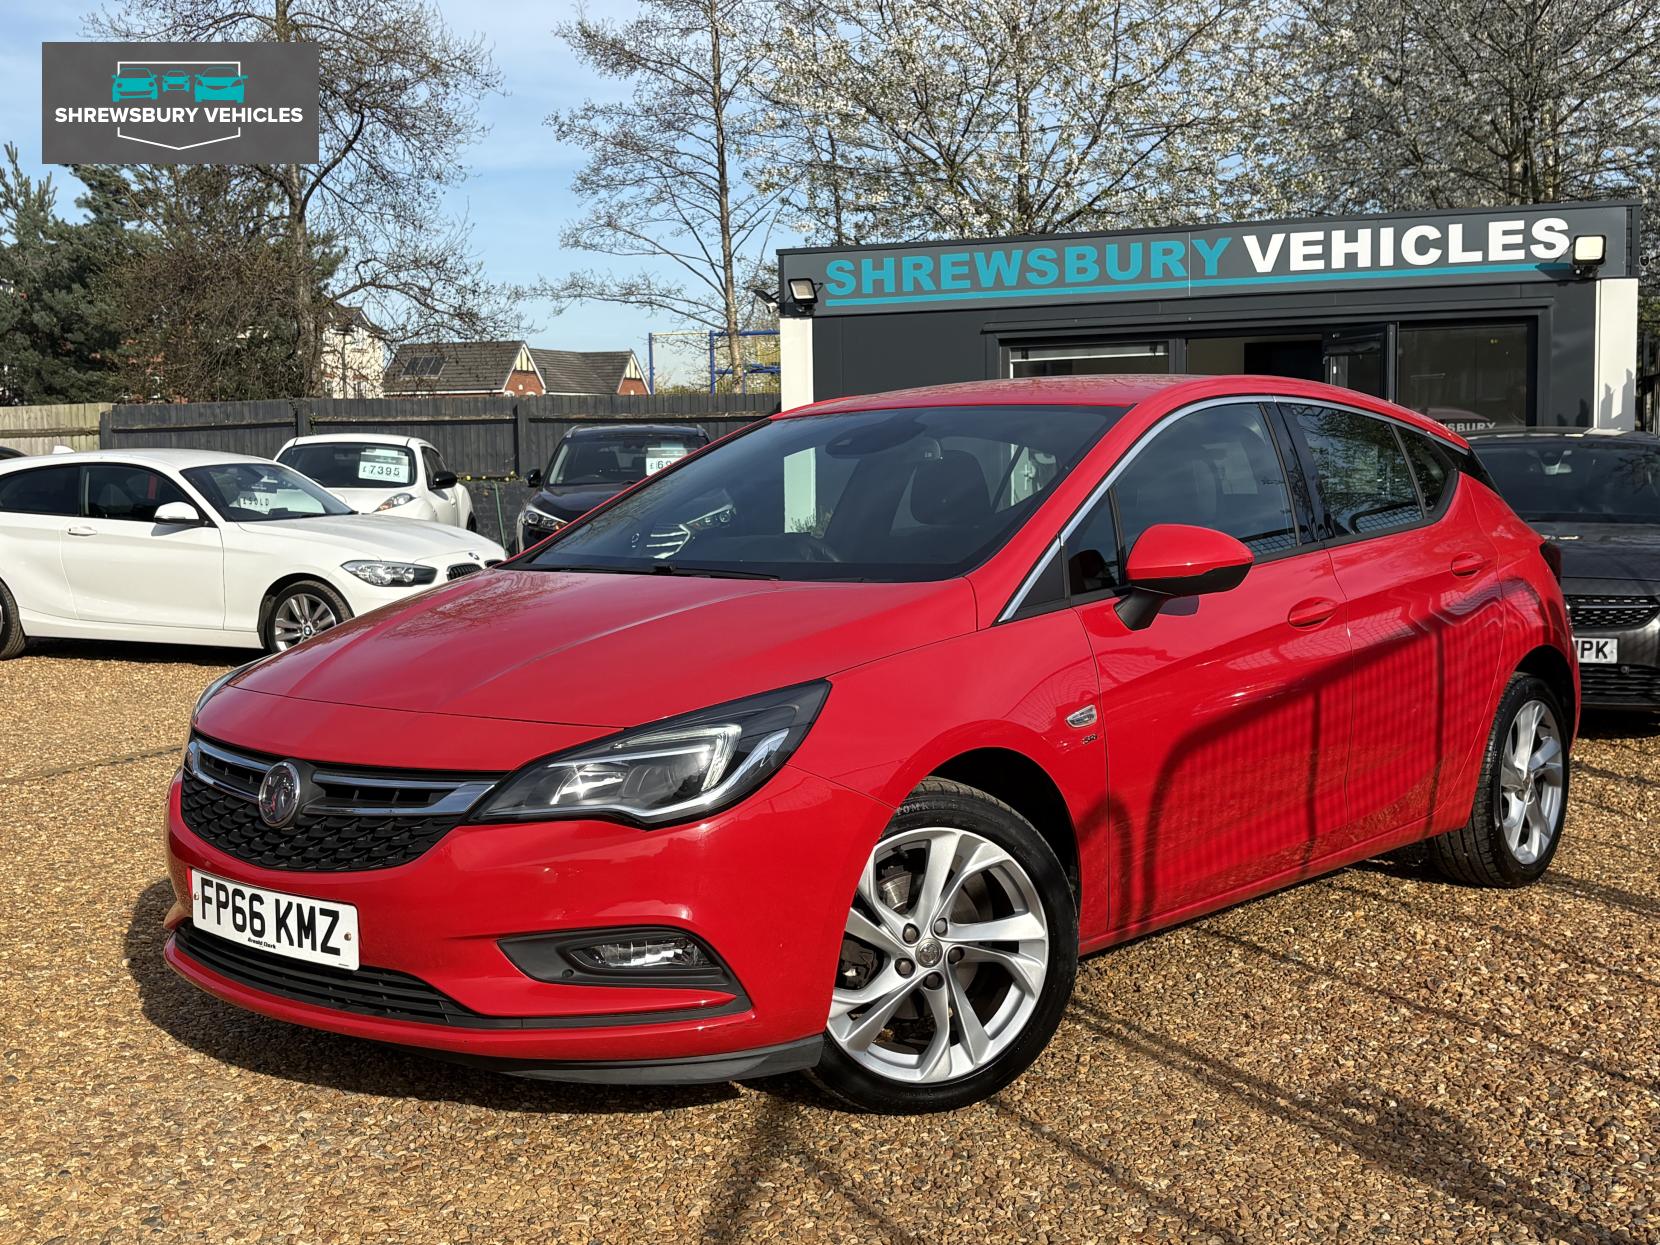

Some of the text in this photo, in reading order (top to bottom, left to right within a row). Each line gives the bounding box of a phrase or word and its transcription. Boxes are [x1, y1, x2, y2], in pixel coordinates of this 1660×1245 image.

[825, 217, 1571, 296] SHREWSBURY VEHICLES
[1444, 422, 1496, 432] SBURY
[200, 876, 341, 957] FP66 KMZ
